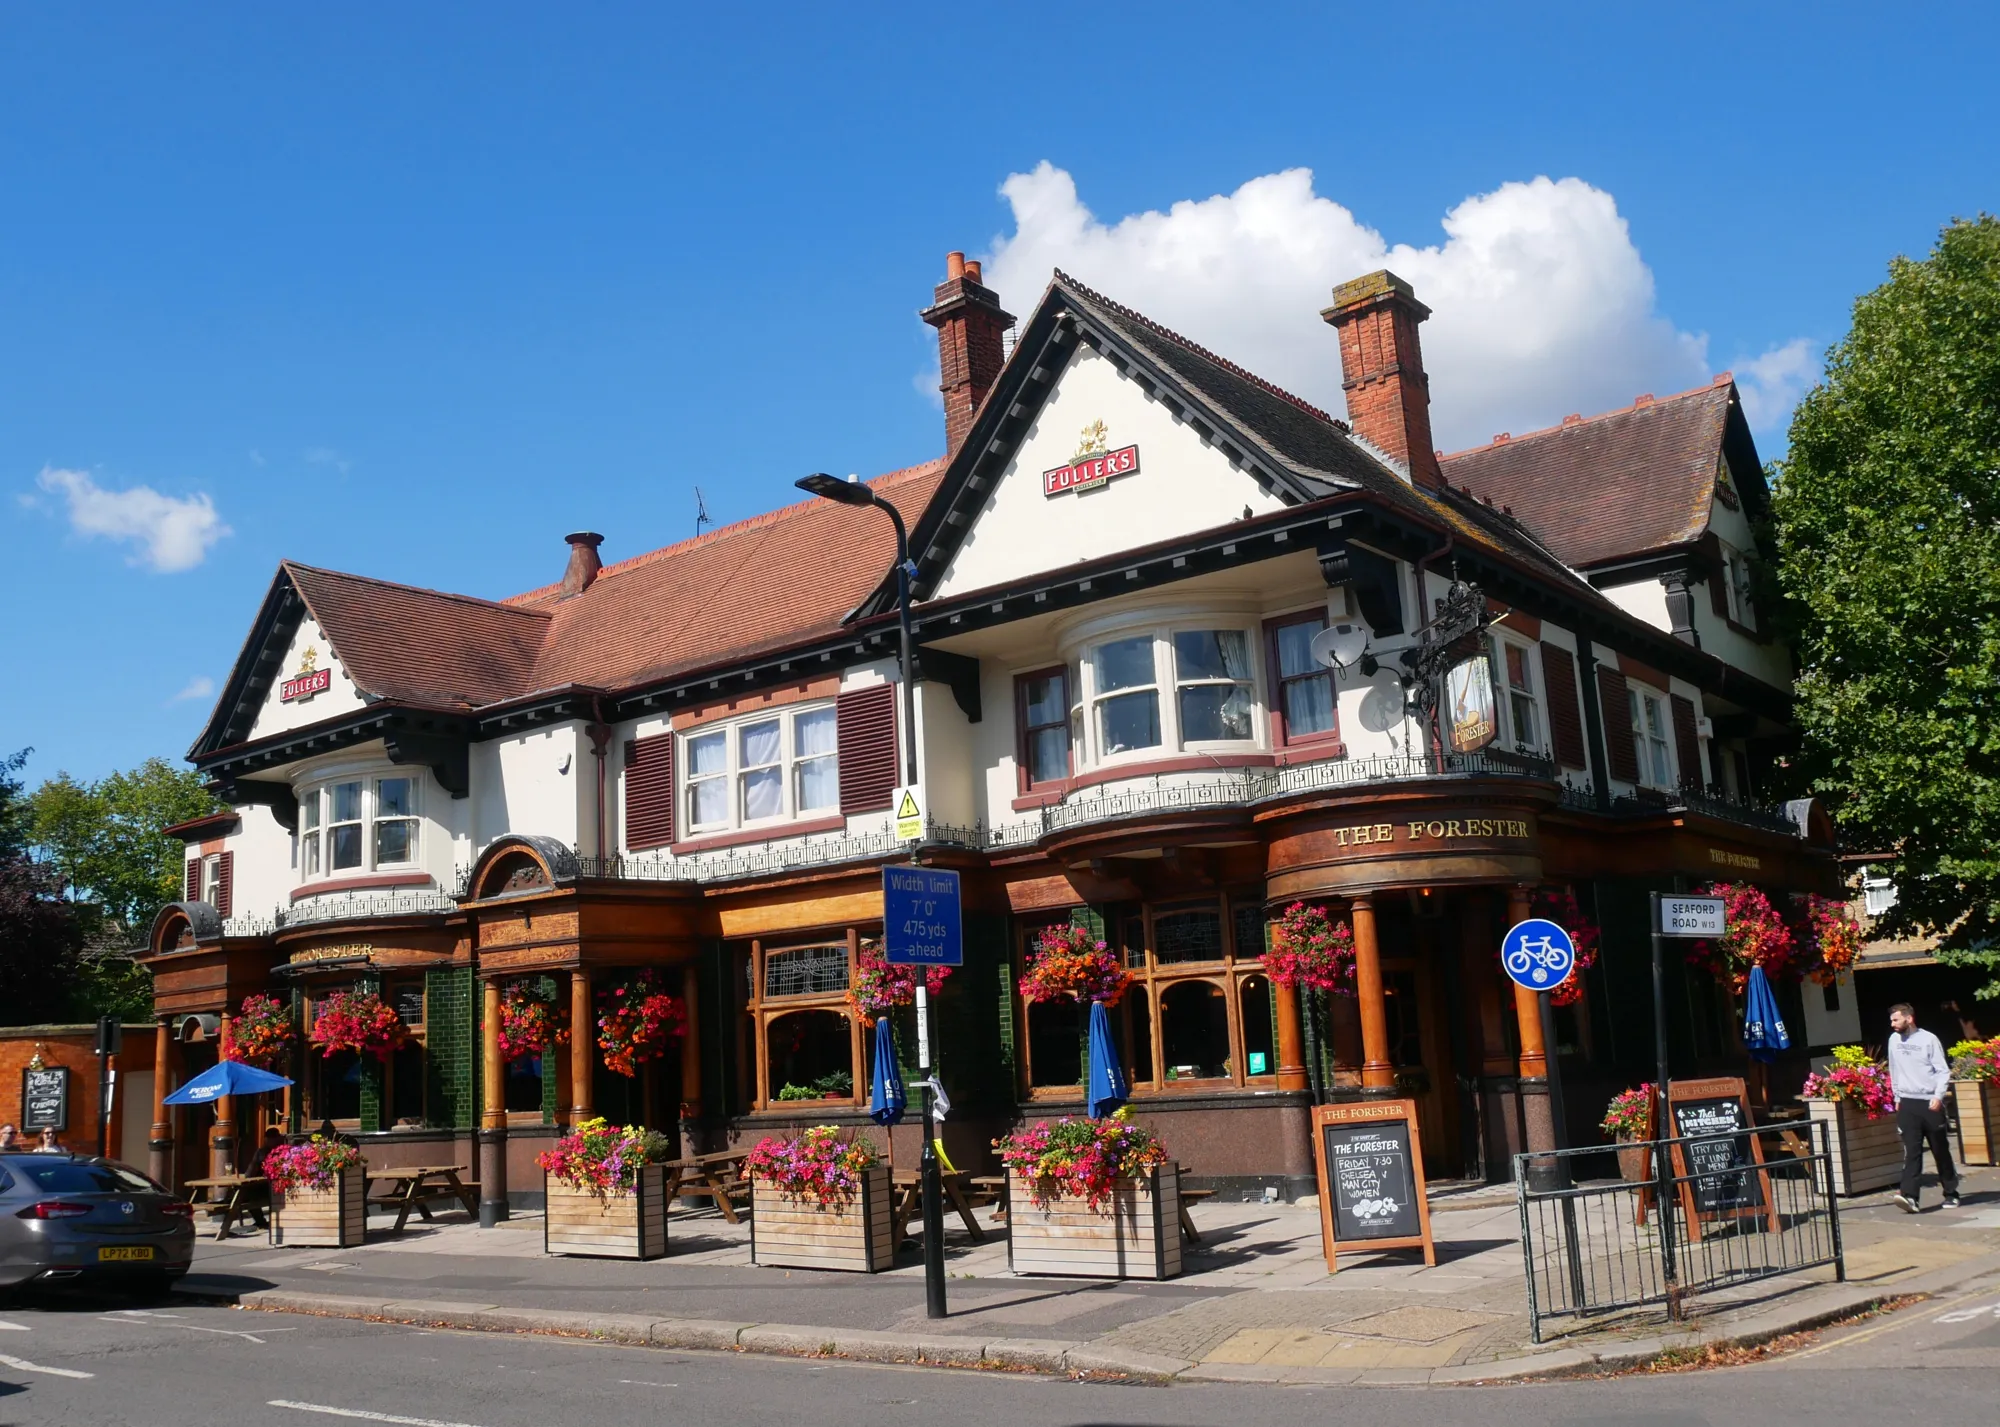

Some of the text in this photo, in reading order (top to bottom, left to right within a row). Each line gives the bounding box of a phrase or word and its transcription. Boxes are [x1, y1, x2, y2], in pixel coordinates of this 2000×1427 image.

[1048, 452, 1130, 490] FULLER'S
[282, 674, 325, 698] FULLER'S
[1454, 721, 1490, 745] FORESTER
[1334, 819, 1529, 846] THE FORESTER
[891, 874, 953, 894] Width limit
[1672, 904, 1715, 914] SEAFORD
[1672, 918, 1697, 928] ROAD
[903, 920, 946, 939] 475 yds
[908, 941, 943, 957] ahead
[189, 1084, 222, 1094] PERONI
[1672, 1084, 1736, 1097] THE FORESTER
[1325, 1105, 1403, 1119] THE FORESTER
[1698, 1107, 1716, 1118] Thai
[1685, 1115, 1735, 1128] KITCHEN
[1334, 1140, 1399, 1154] THE FORESTER
[1694, 1143, 1729, 1154] TRY OUR
[1338, 1157, 1369, 1169] FRIDAY
[1692, 1154, 1706, 1165] SET
[1340, 1170, 1376, 1180] CHELSEA
[1342, 1179, 1380, 1189] MAN CITY
[1349, 1188, 1380, 1198] WOMEN
[103, 1248, 129, 1259] LP72
